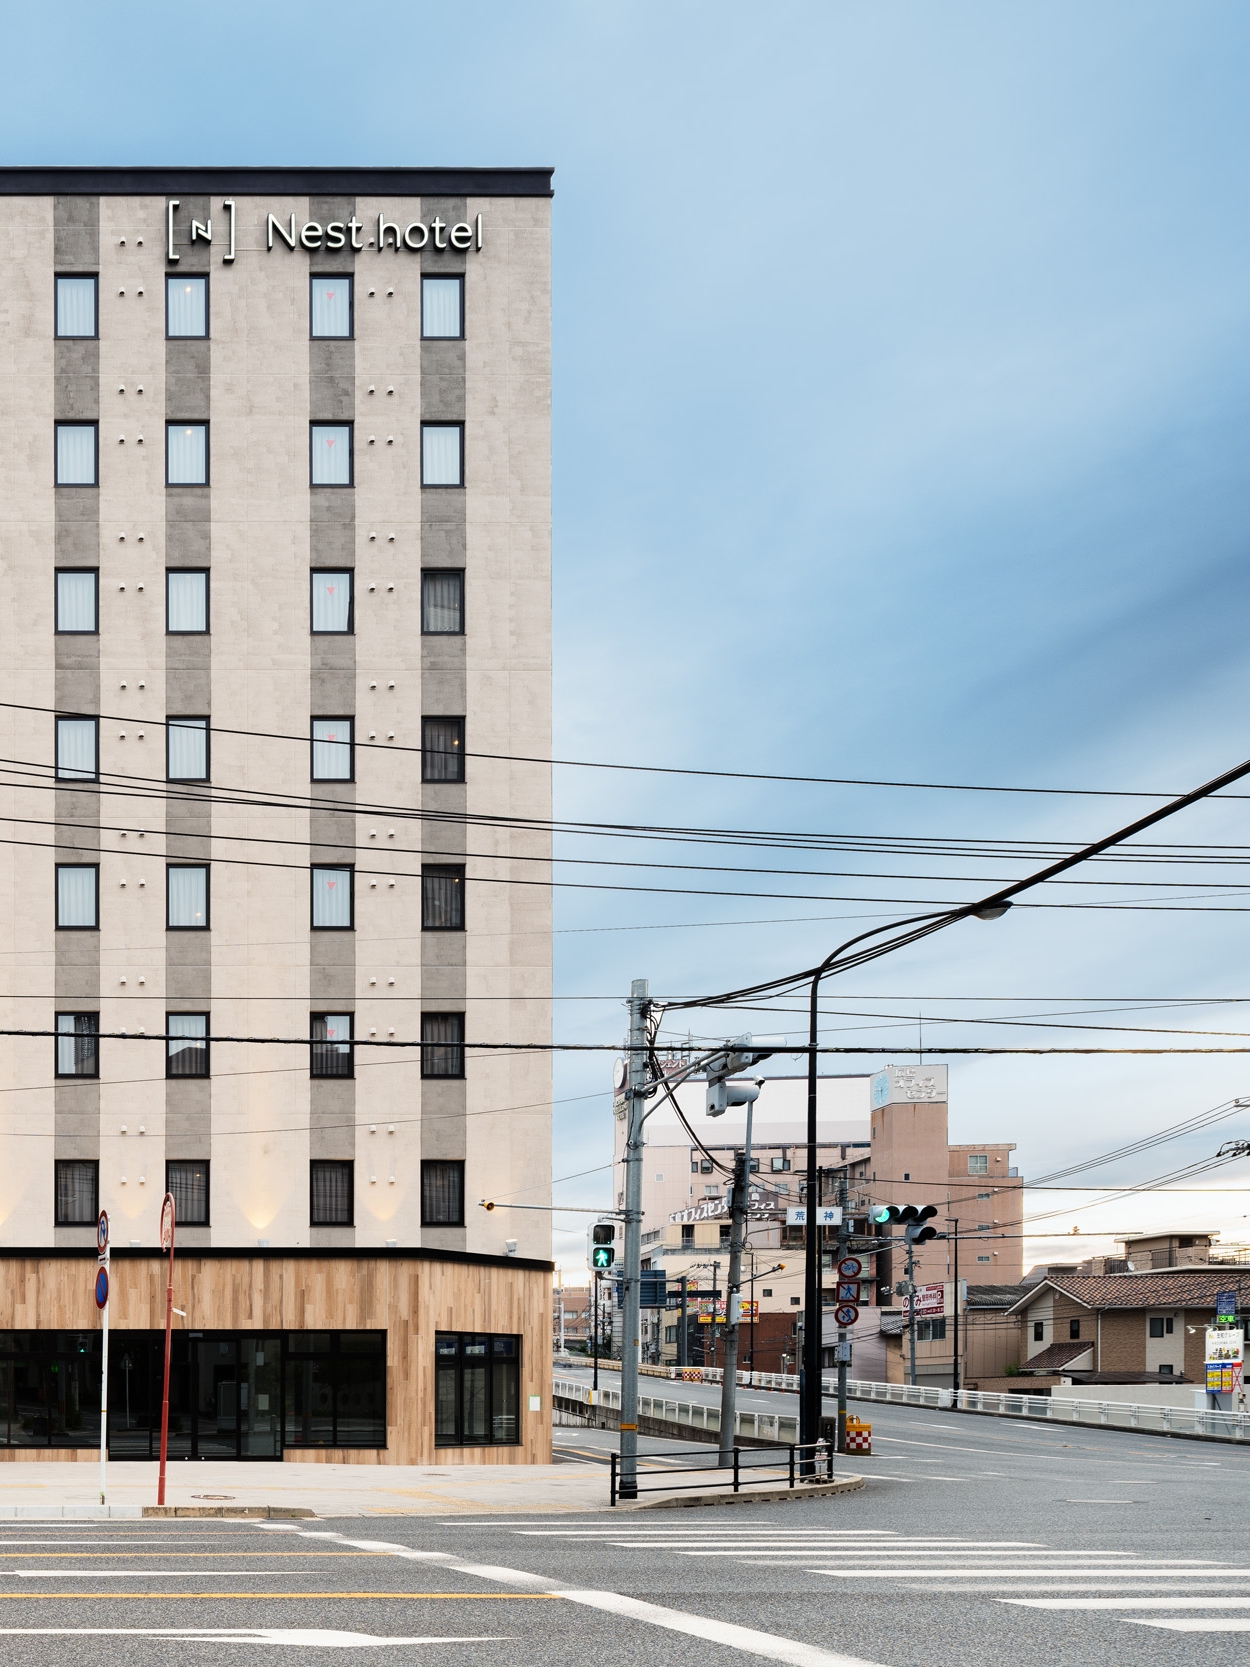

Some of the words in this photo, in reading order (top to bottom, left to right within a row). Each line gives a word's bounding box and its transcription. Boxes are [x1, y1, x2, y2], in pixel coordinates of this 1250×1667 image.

[267, 213, 363, 251] Nest
[378, 213, 483, 251] hotel
[669, 1197, 729, 1223] 広島オフィスセンタ
